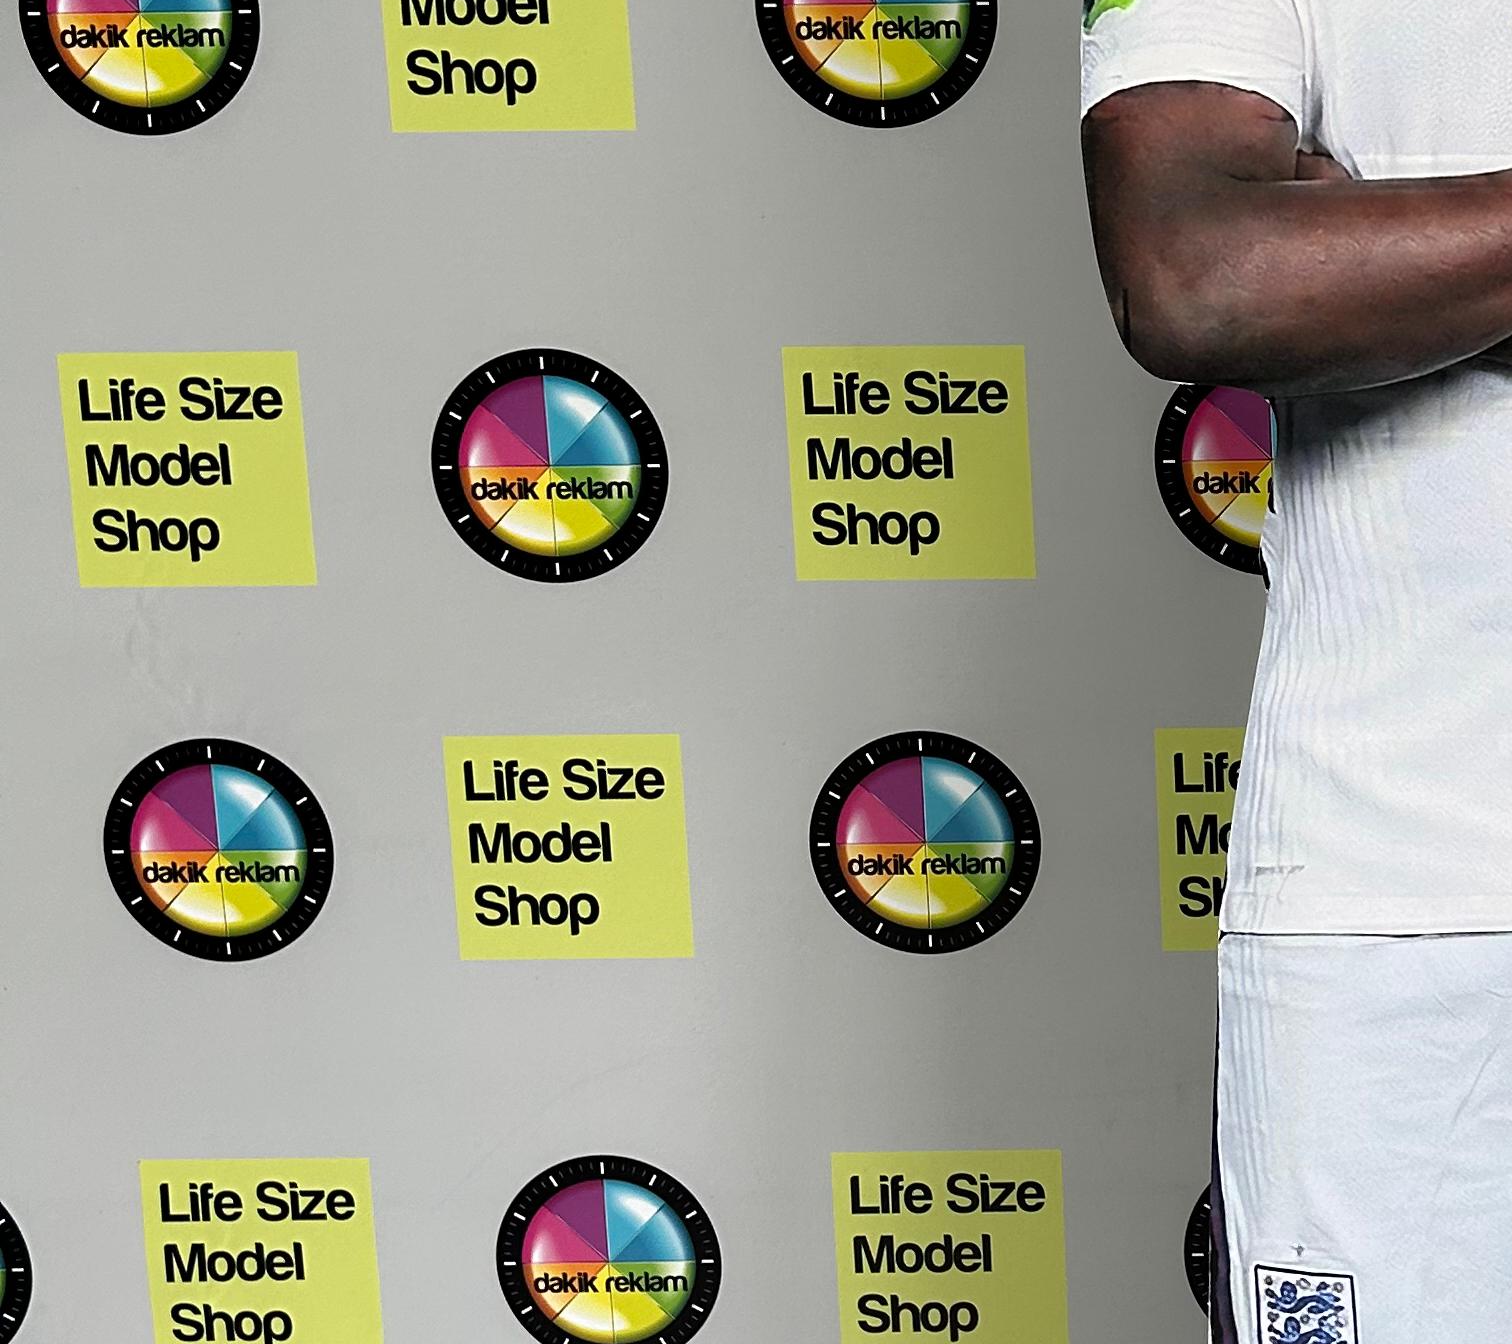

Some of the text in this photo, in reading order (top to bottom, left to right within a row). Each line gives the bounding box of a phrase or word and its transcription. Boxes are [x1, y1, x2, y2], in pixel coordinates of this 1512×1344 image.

[60, 23, 226, 49] dakik reklam
[795, 13, 962, 41] dakik reklam
[406, 49, 537, 106] Shop
[78, 376, 283, 422] Life Size
[802, 370, 1009, 415] Life Size
[84, 442, 232, 487] Model
[806, 436, 954, 481] Model
[471, 476, 634, 501] dakik reklam
[1192, 470, 1261, 494] dakik
[92, 508, 220, 563] Shop
[811, 502, 941, 556] Shop
[463, 758, 665, 802] Life Size
[468, 821, 613, 864] Model
[142, 859, 301, 884] dakik reklam
[847, 853, 1006, 876] dakik reklam
[474, 884, 600, 936] Shop
[159, 1180, 356, 1223] Life Size
[849, 1172, 1046, 1215] Life Size
[163, 1241, 306, 1283] Model
[852, 1233, 993, 1274] Model
[533, 1271, 689, 1294] dakik reklam
[857, 1293, 979, 1343] Shop
